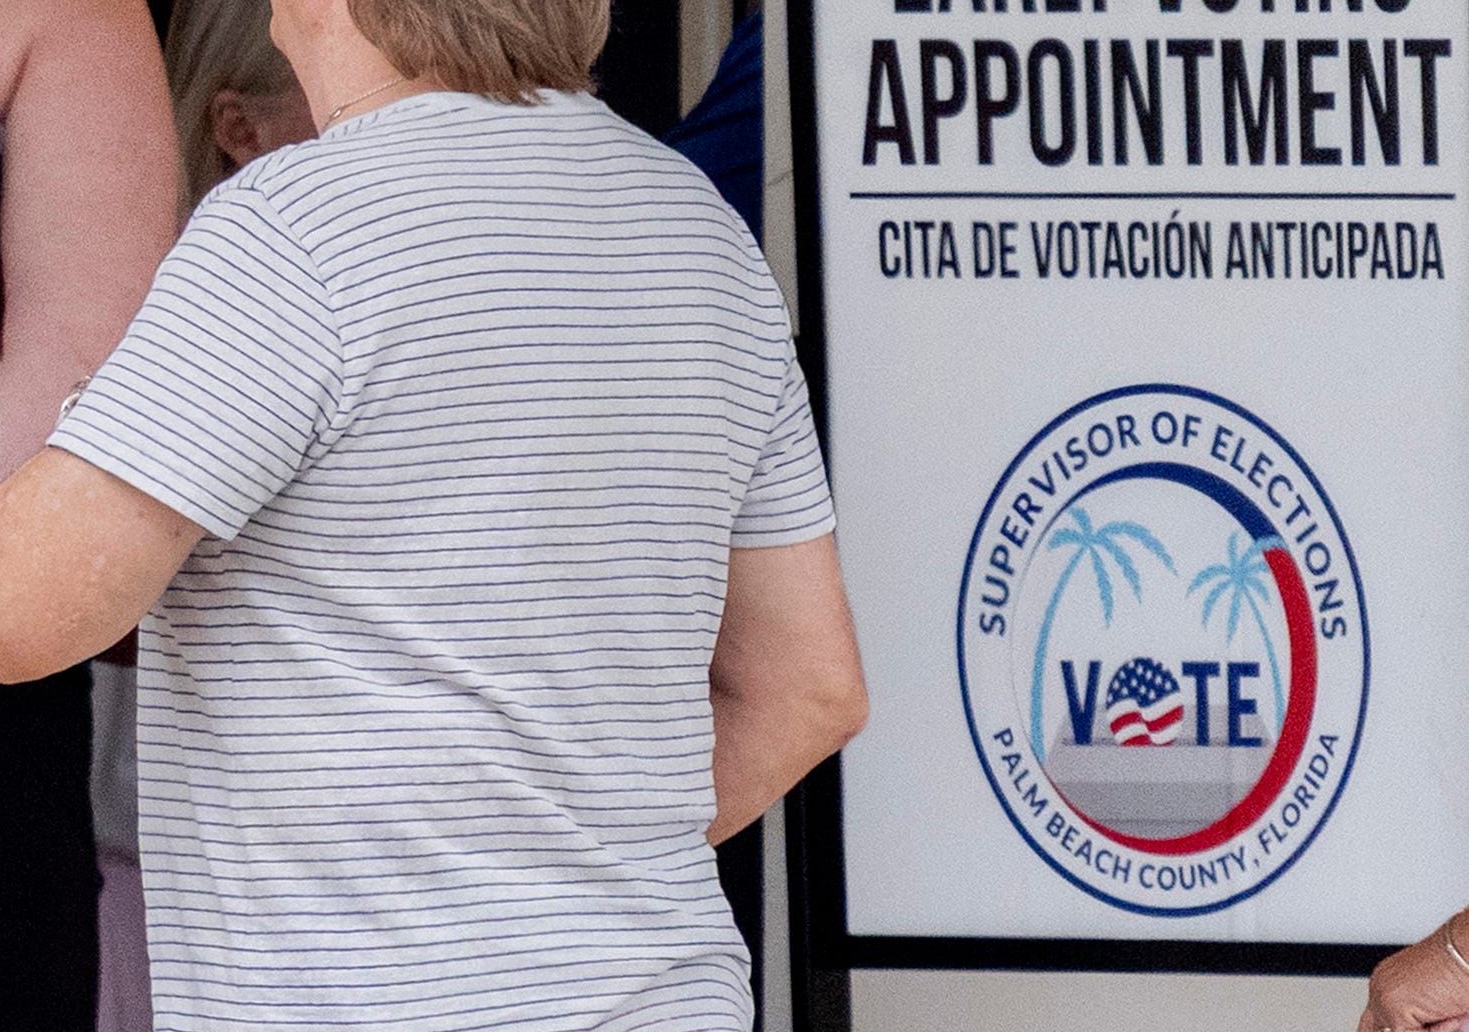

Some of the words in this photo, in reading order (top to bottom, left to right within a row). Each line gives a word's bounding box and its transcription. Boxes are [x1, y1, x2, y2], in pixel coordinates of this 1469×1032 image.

[861, 38, 1452, 167] APPOINTMENT
[878, 220, 962, 279] CITA
[973, 221, 1019, 279] DE
[1030, 209, 1213, 280] VOTACIÓN
[1225, 221, 1445, 280] ANTICIPADA
[978, 414, 1142, 637] SUPERVISOR
[1150, 410, 1202, 448] OF
[1209, 424, 1347, 641] ELECTIONS
[992, 726, 1049, 818] PALM
[1044, 811, 1132, 885] BEACH
[1138, 846, 1261, 892] COUNTY,
[1257, 733, 1339, 858] FLORIDA
